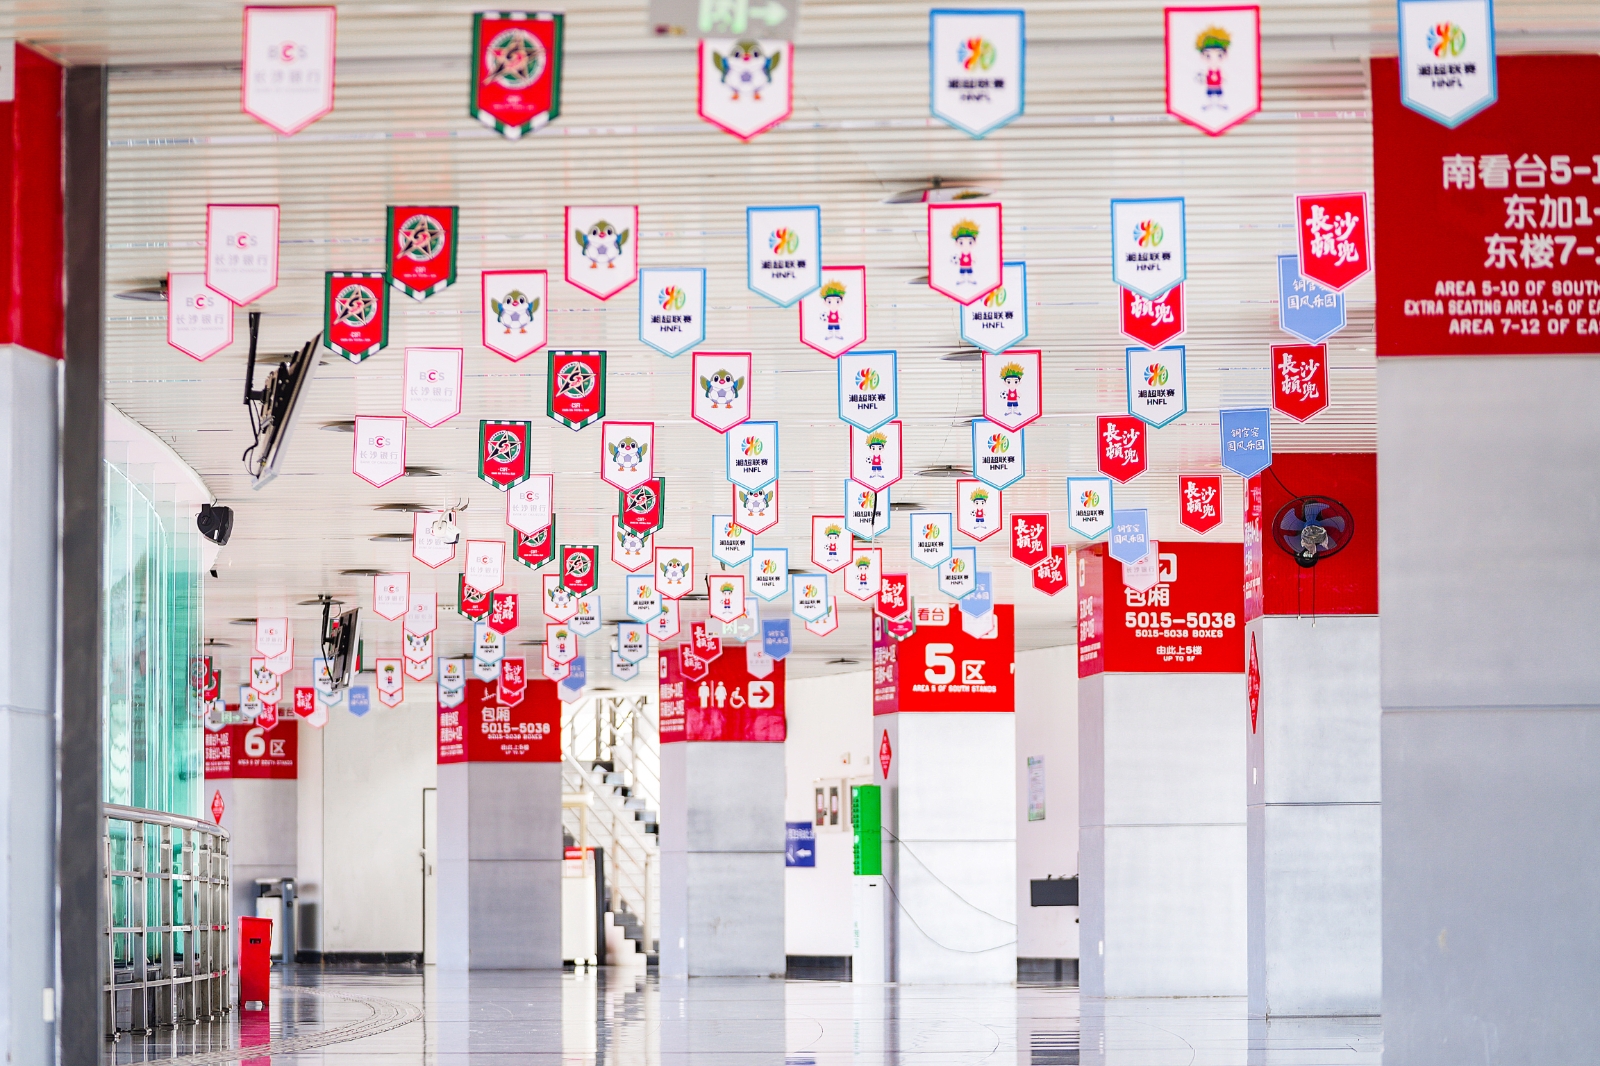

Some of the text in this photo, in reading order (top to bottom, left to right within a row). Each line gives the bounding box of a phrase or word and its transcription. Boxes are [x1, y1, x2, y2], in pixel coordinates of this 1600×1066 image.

[1306, 204, 1360, 242] 長沙
[226, 234, 258, 247] BCS
[1484, 232, 1600, 269] 东楼7-
[1434, 280, 1476, 297] AREA
[1481, 280, 1519, 297] 5-10
[1525, 280, 1546, 297] OF
[186, 297, 215, 308] BCS
[1287, 293, 1337, 310] 国风乐园
[1404, 299, 1444, 316] EXTRA
[1448, 299, 1501, 316] SEATING
[1505, 299, 1538, 315] AREA
[1542, 299, 1564, 315] 1-6
[1567, 299, 1584, 315] OF
[176, 314, 225, 326] 长沙银行
[1449, 318, 1600, 335] AREA 7-12 OF EA
[1278, 352, 1320, 382] 長沙
[419, 371, 445, 382] BCS
[410, 386, 453, 397] 长沙银行
[1138, 388, 1175, 398] 湘超联赛
[849, 393, 886, 403] 湘超联赛
[1146, 398, 1168, 406] HNFL
[1102, 422, 1140, 448] 長沙
[368, 437, 391, 447] BCS
[1227, 439, 1265, 452] 国风乐园
[360, 450, 399, 460] 长沙银行
[982, 456, 1015, 464] 湘超联赛
[735, 458, 768, 467] 湘超联赛
[743, 466, 762, 474] HNFL
[519, 492, 540, 500] BCS
[1184, 481, 1217, 504] 長沙
[512, 504, 547, 512] 长沙银行
[1014, 518, 1045, 540] 長沙
[476, 556, 494, 564] BCS
[1041, 555, 1063, 573] 沙
[1135, 629, 1224, 638] 5015-5038 BOXES
[1156, 645, 1203, 655] 由此上5楼
[912, 684, 930, 692] AREA
[948, 685, 970, 693] SOUTH
[971, 685, 997, 693] STANDS
[481, 706, 511, 721] 包厢
